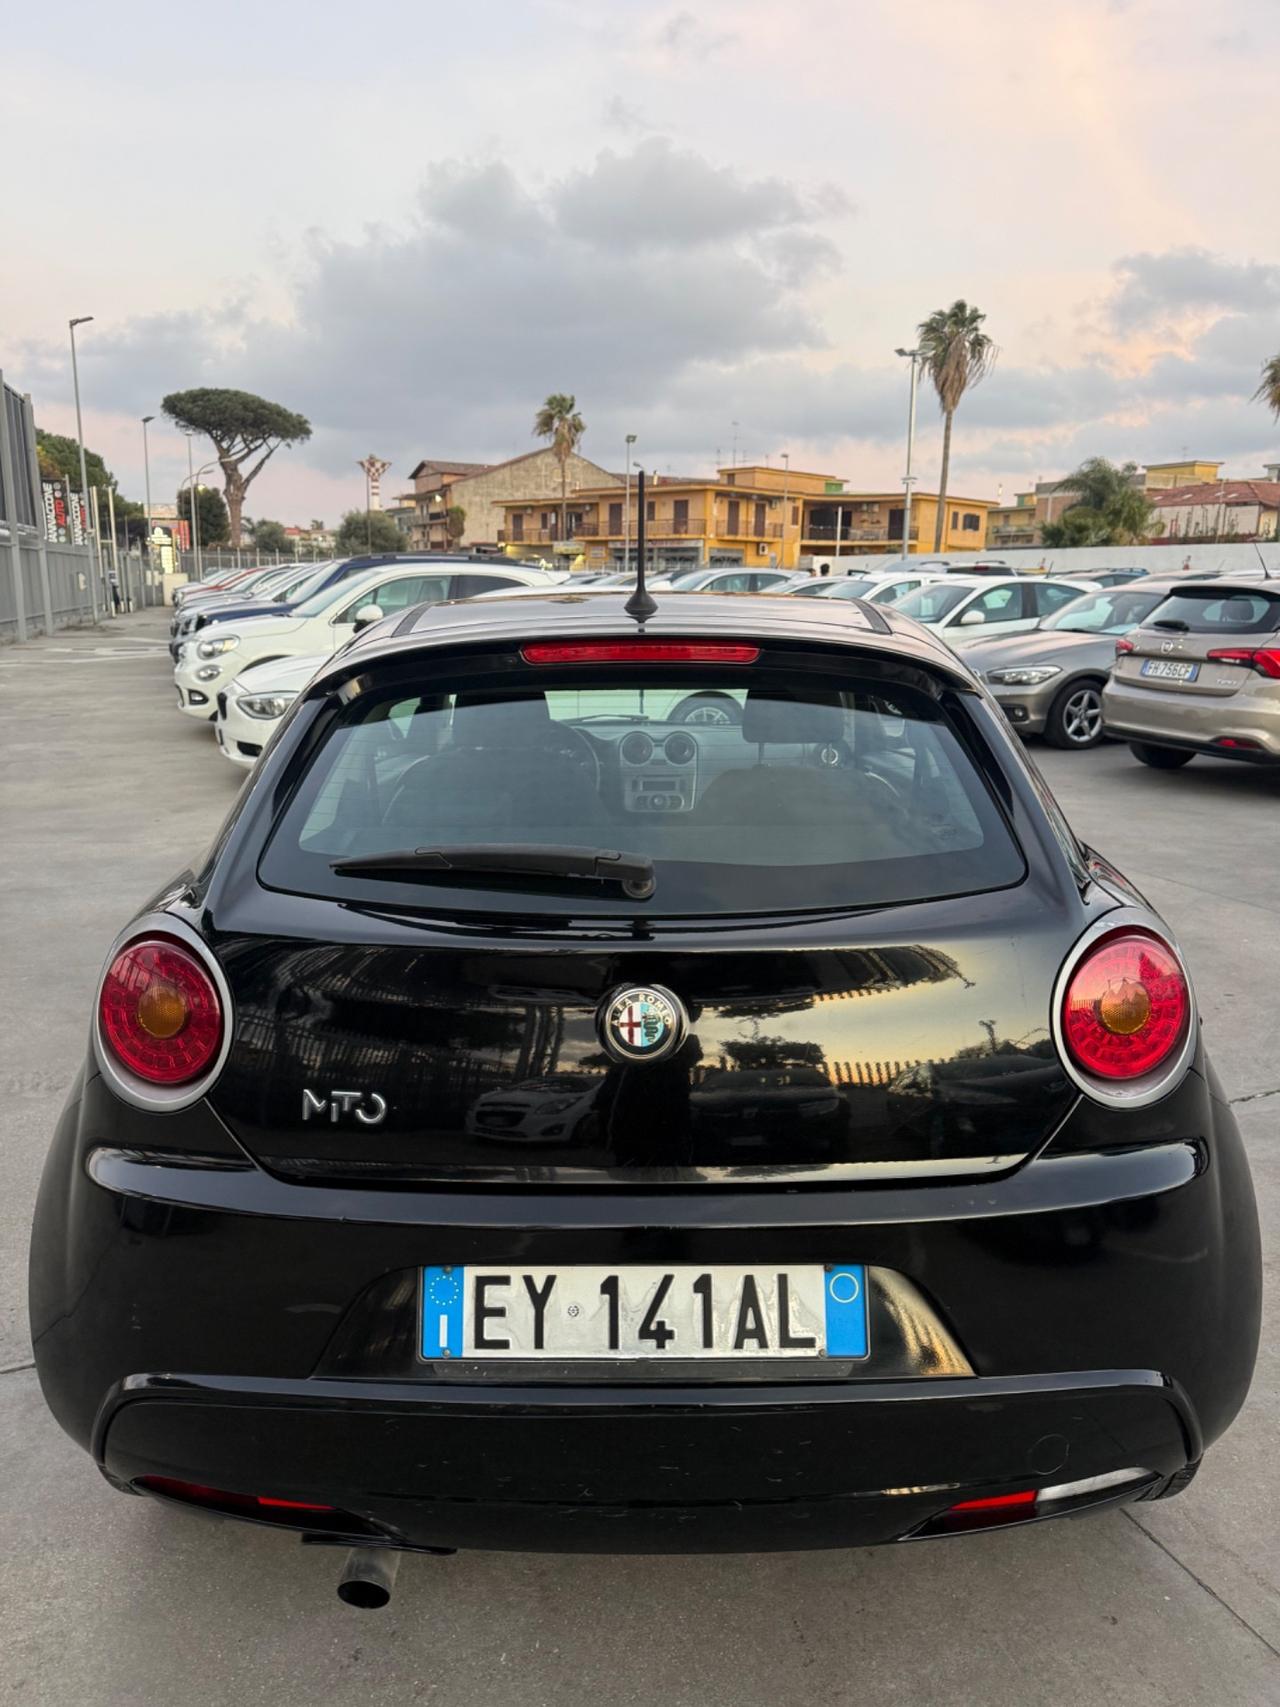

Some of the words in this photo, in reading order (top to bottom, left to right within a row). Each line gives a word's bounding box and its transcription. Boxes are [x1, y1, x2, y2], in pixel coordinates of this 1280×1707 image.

[611, 998, 633, 1027] ALFA
[639, 992, 672, 1025] ROMEO
[473, 1274, 557, 1351] EY
[600, 1273, 817, 1350] 141AL
